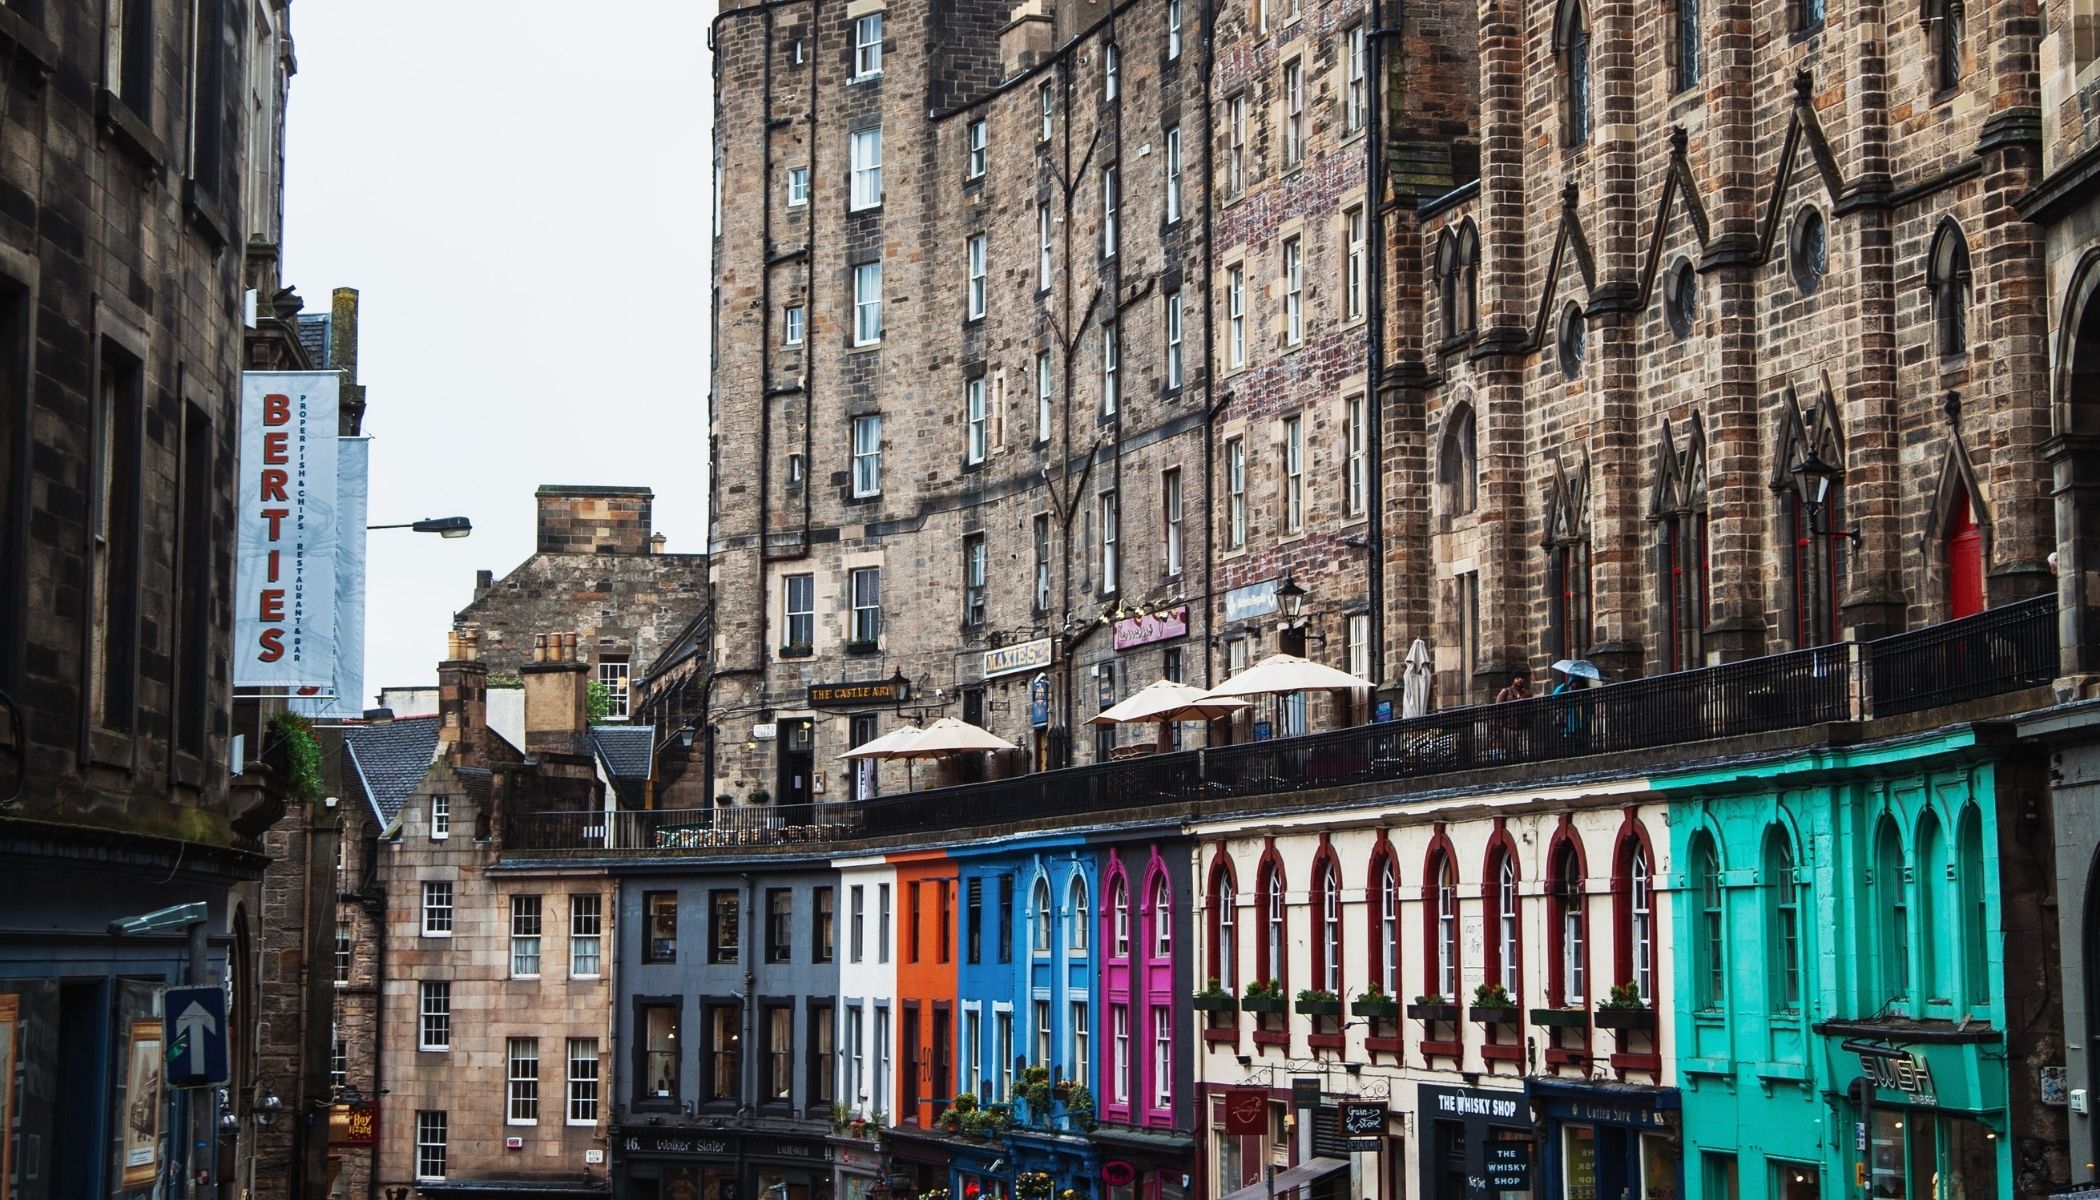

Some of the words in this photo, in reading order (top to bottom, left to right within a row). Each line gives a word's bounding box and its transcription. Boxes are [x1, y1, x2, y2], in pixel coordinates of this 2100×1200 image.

[299, 394, 307, 442] PROPER
[298, 445, 306, 477] FISH
[297, 490, 305, 530] CHIPS
[257, 393, 292, 663] BERTIES
[294, 543, 304, 625] RESTAURANT
[294, 627, 301, 635] &
[293, 637, 302, 662] BAR
[986, 647, 1037, 672] MAXIES
[812, 689, 833, 700] THE
[834, 687, 870, 699] CASTLE
[920, 1046, 932, 1083] 40
[1858, 1053, 1935, 1094] SWISH
[1438, 1094, 1456, 1111] THE
[1456, 1095, 1491, 1116] WHISKY
[1492, 1099, 1517, 1117] SHOP
[353, 1113, 372, 1126] Boy
[656, 1139, 691, 1151] Walker
[697, 1139, 727, 1153] Slater
[1497, 1150, 1516, 1158] THE
[1488, 1163, 1527, 1171] WHISKY
[1494, 1177, 1520, 1185] SHOP
